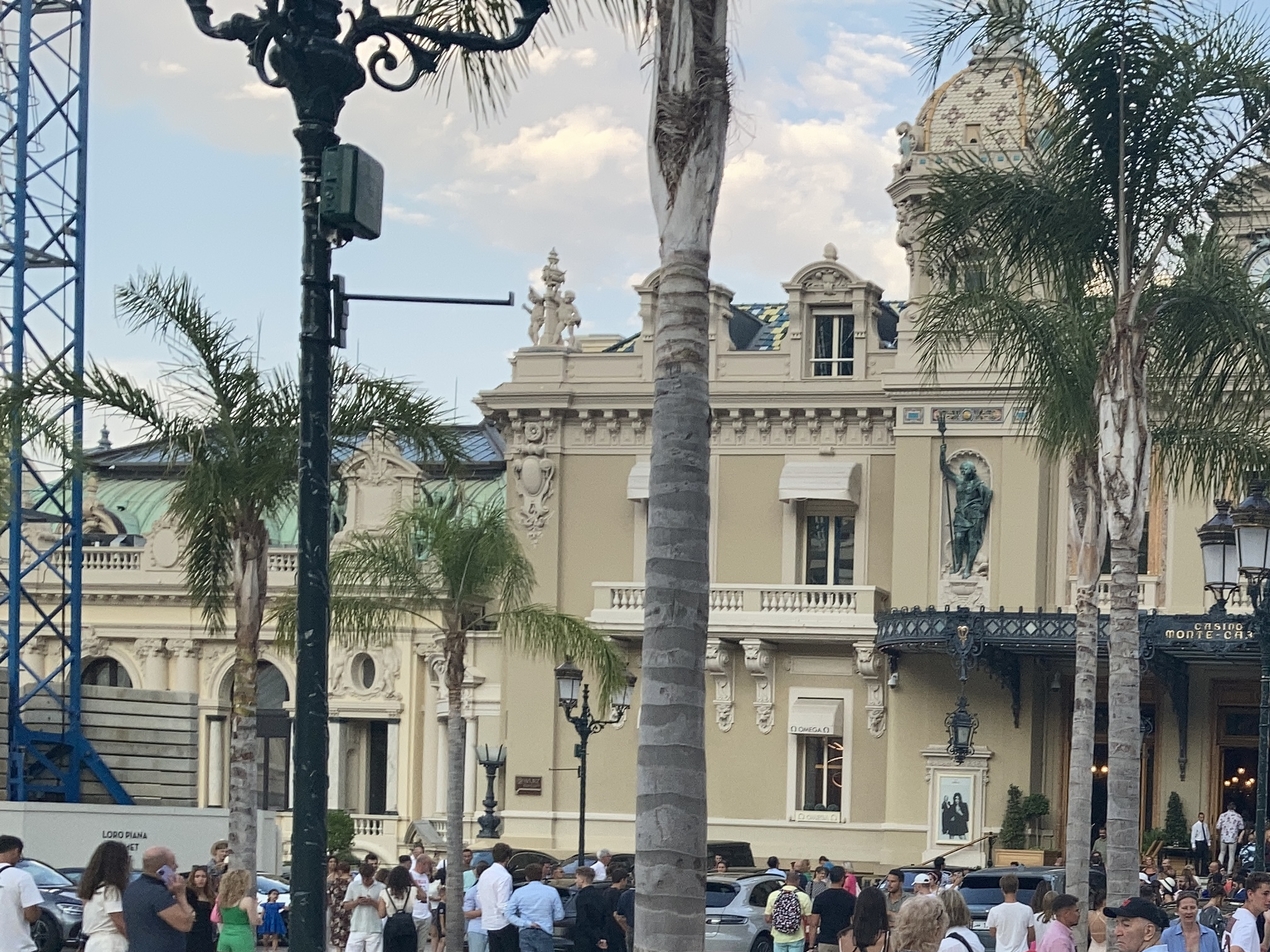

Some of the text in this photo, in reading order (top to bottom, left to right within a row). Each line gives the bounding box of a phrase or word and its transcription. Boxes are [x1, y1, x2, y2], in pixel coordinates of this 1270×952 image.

[1194, 622, 1243, 631] CASINO
[102, 830, 148, 839] LORO PIANA
